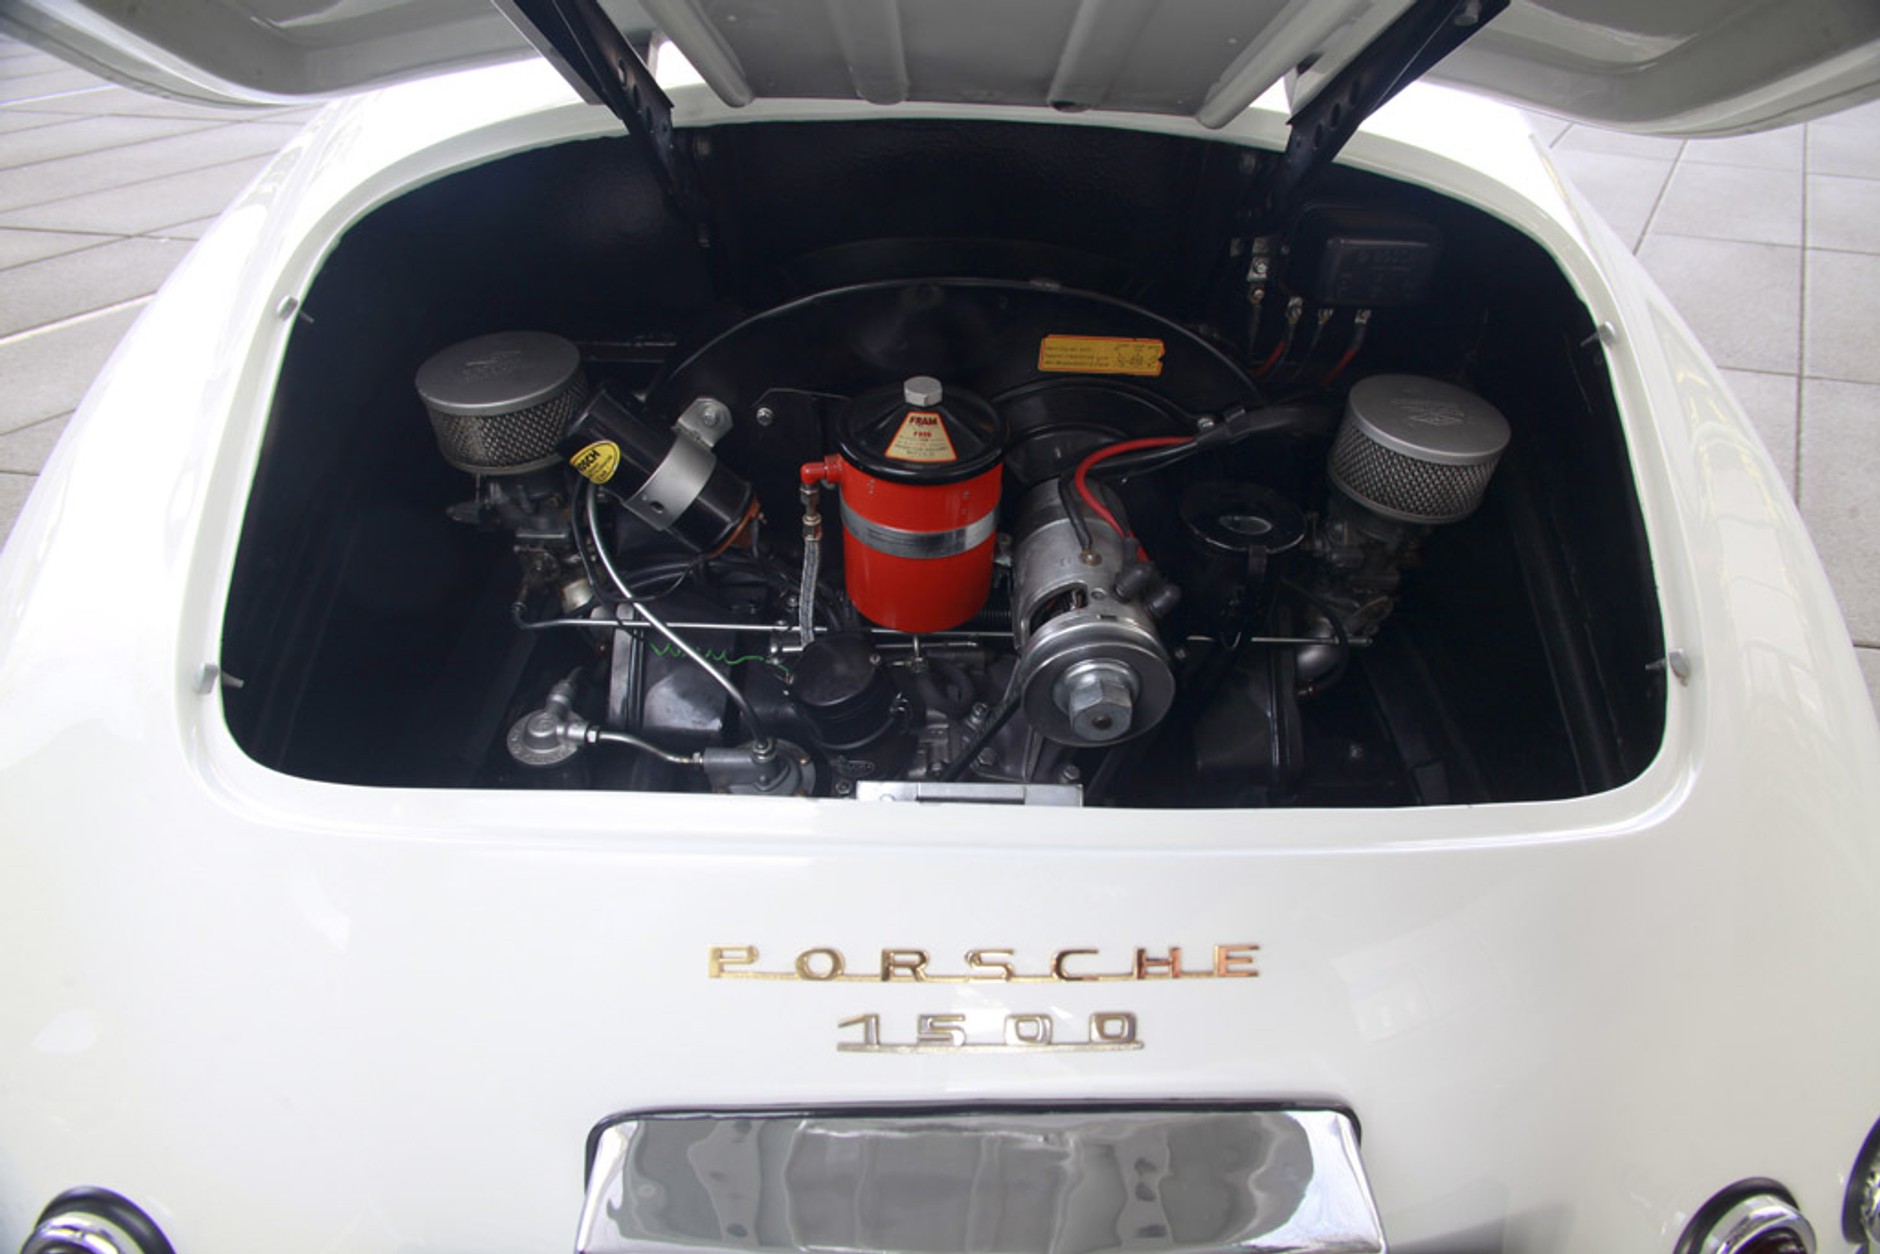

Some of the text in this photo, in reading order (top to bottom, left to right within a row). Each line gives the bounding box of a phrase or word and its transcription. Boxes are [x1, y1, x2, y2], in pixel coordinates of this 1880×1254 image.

[909, 415, 938, 426] FRAM
[575, 449, 602, 472] OSCH
[708, 943, 1261, 982] PORSCHE
[836, 1013, 1144, 1052] 1500
